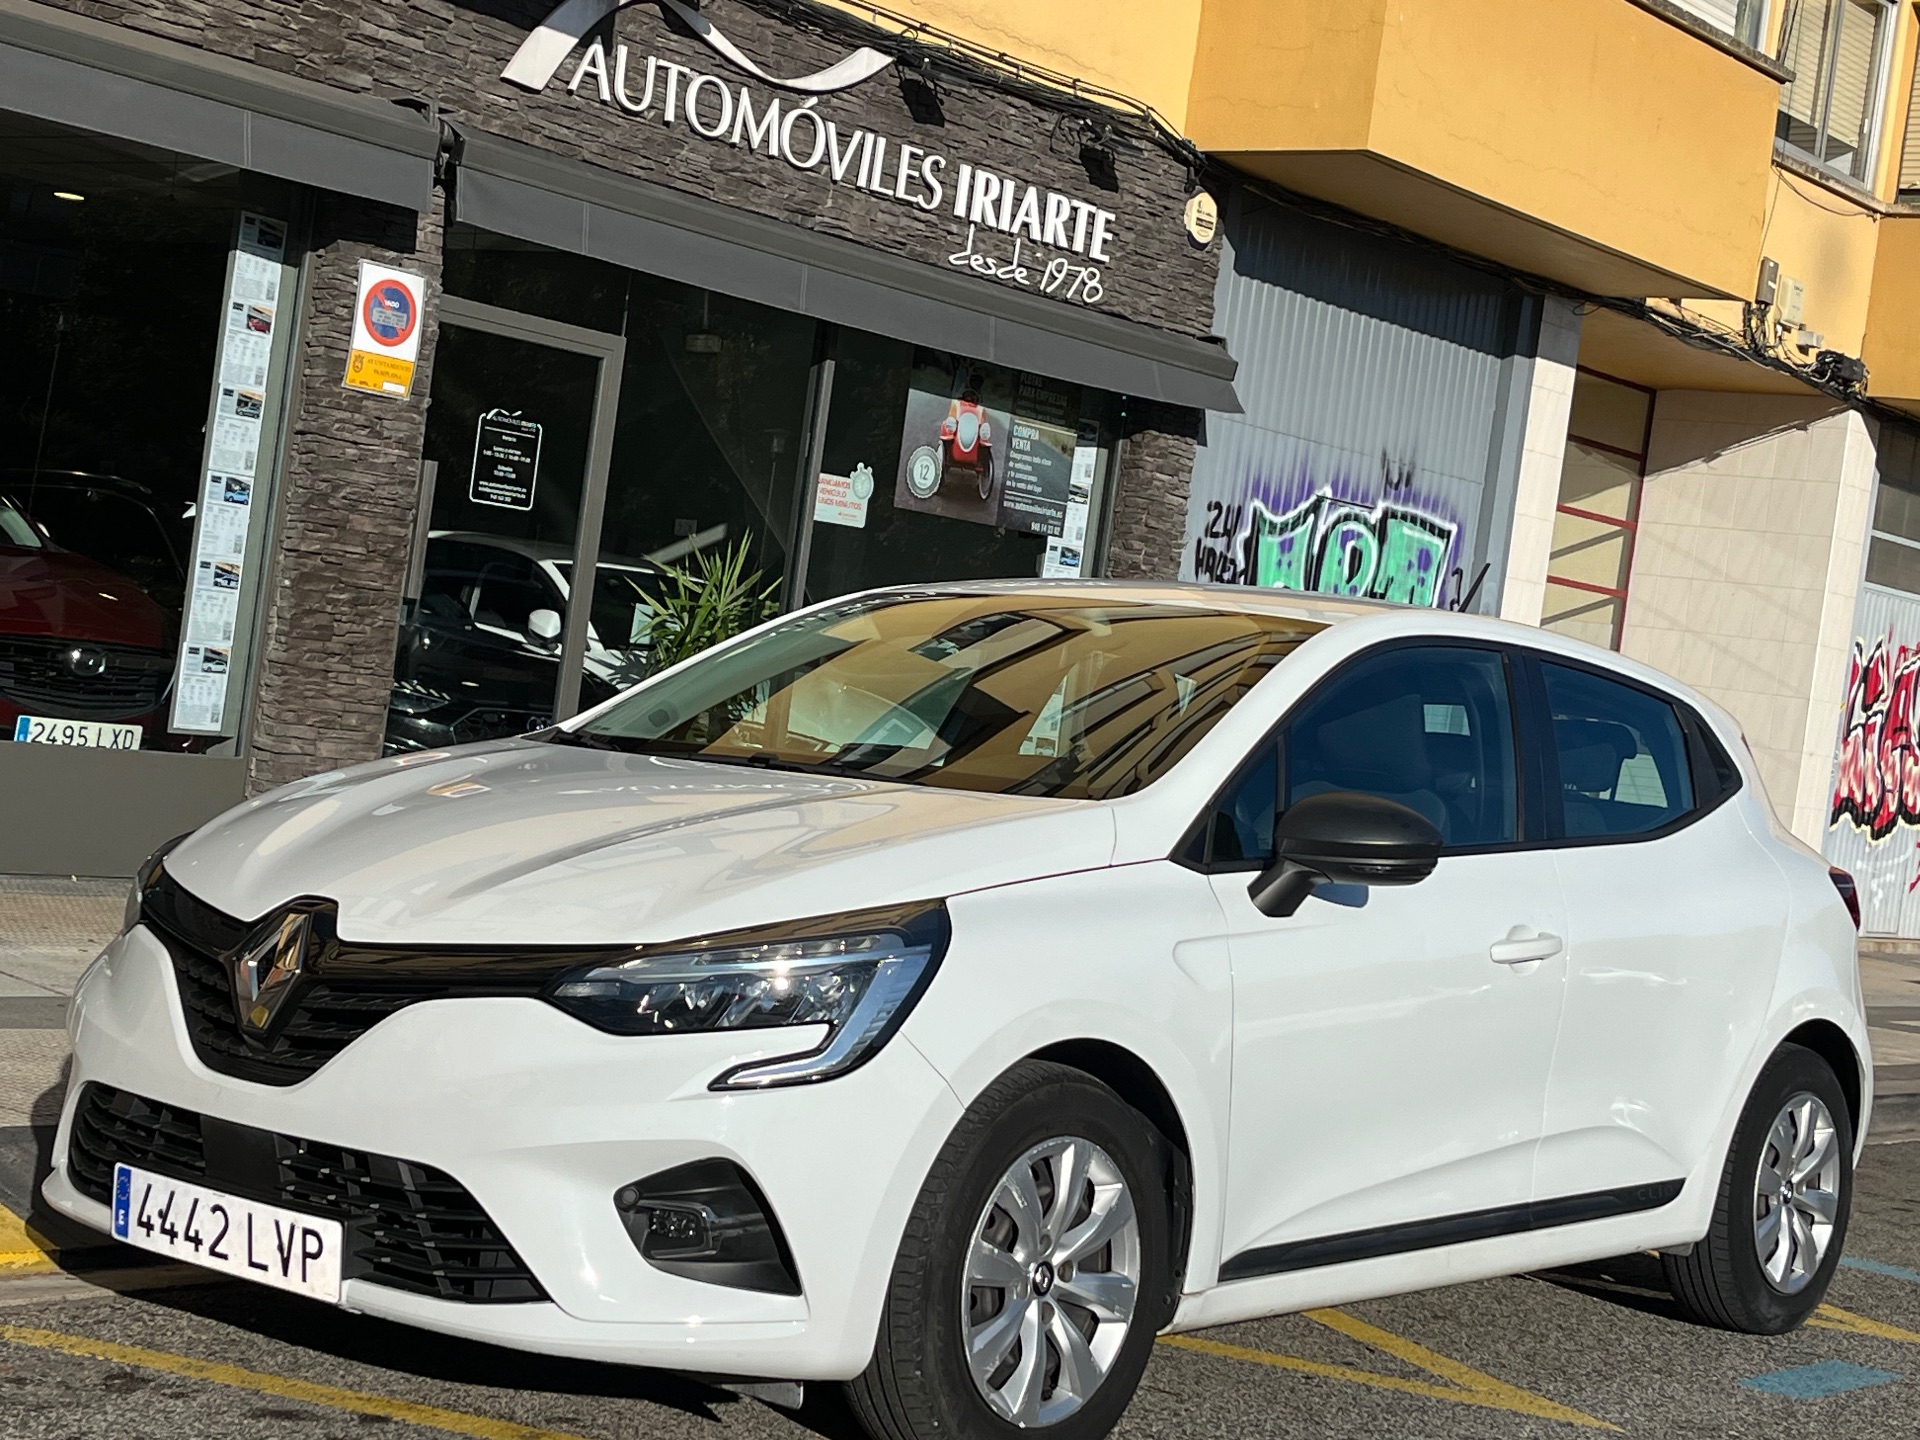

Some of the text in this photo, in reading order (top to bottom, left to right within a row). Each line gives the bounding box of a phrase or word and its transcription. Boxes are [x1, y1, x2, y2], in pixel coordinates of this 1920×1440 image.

[567, 36, 1115, 262] AUTOMÓVILES IRIARTE
[948, 224, 1104, 303] desde 1978
[1012, 437, 1031, 451] VENTA
[1014, 425, 1039, 441] COMPRA
[920, 464, 929, 480] 12
[31, 722, 134, 750] 2495 LXD
[137, 1183, 324, 1283] 4442 LVP
